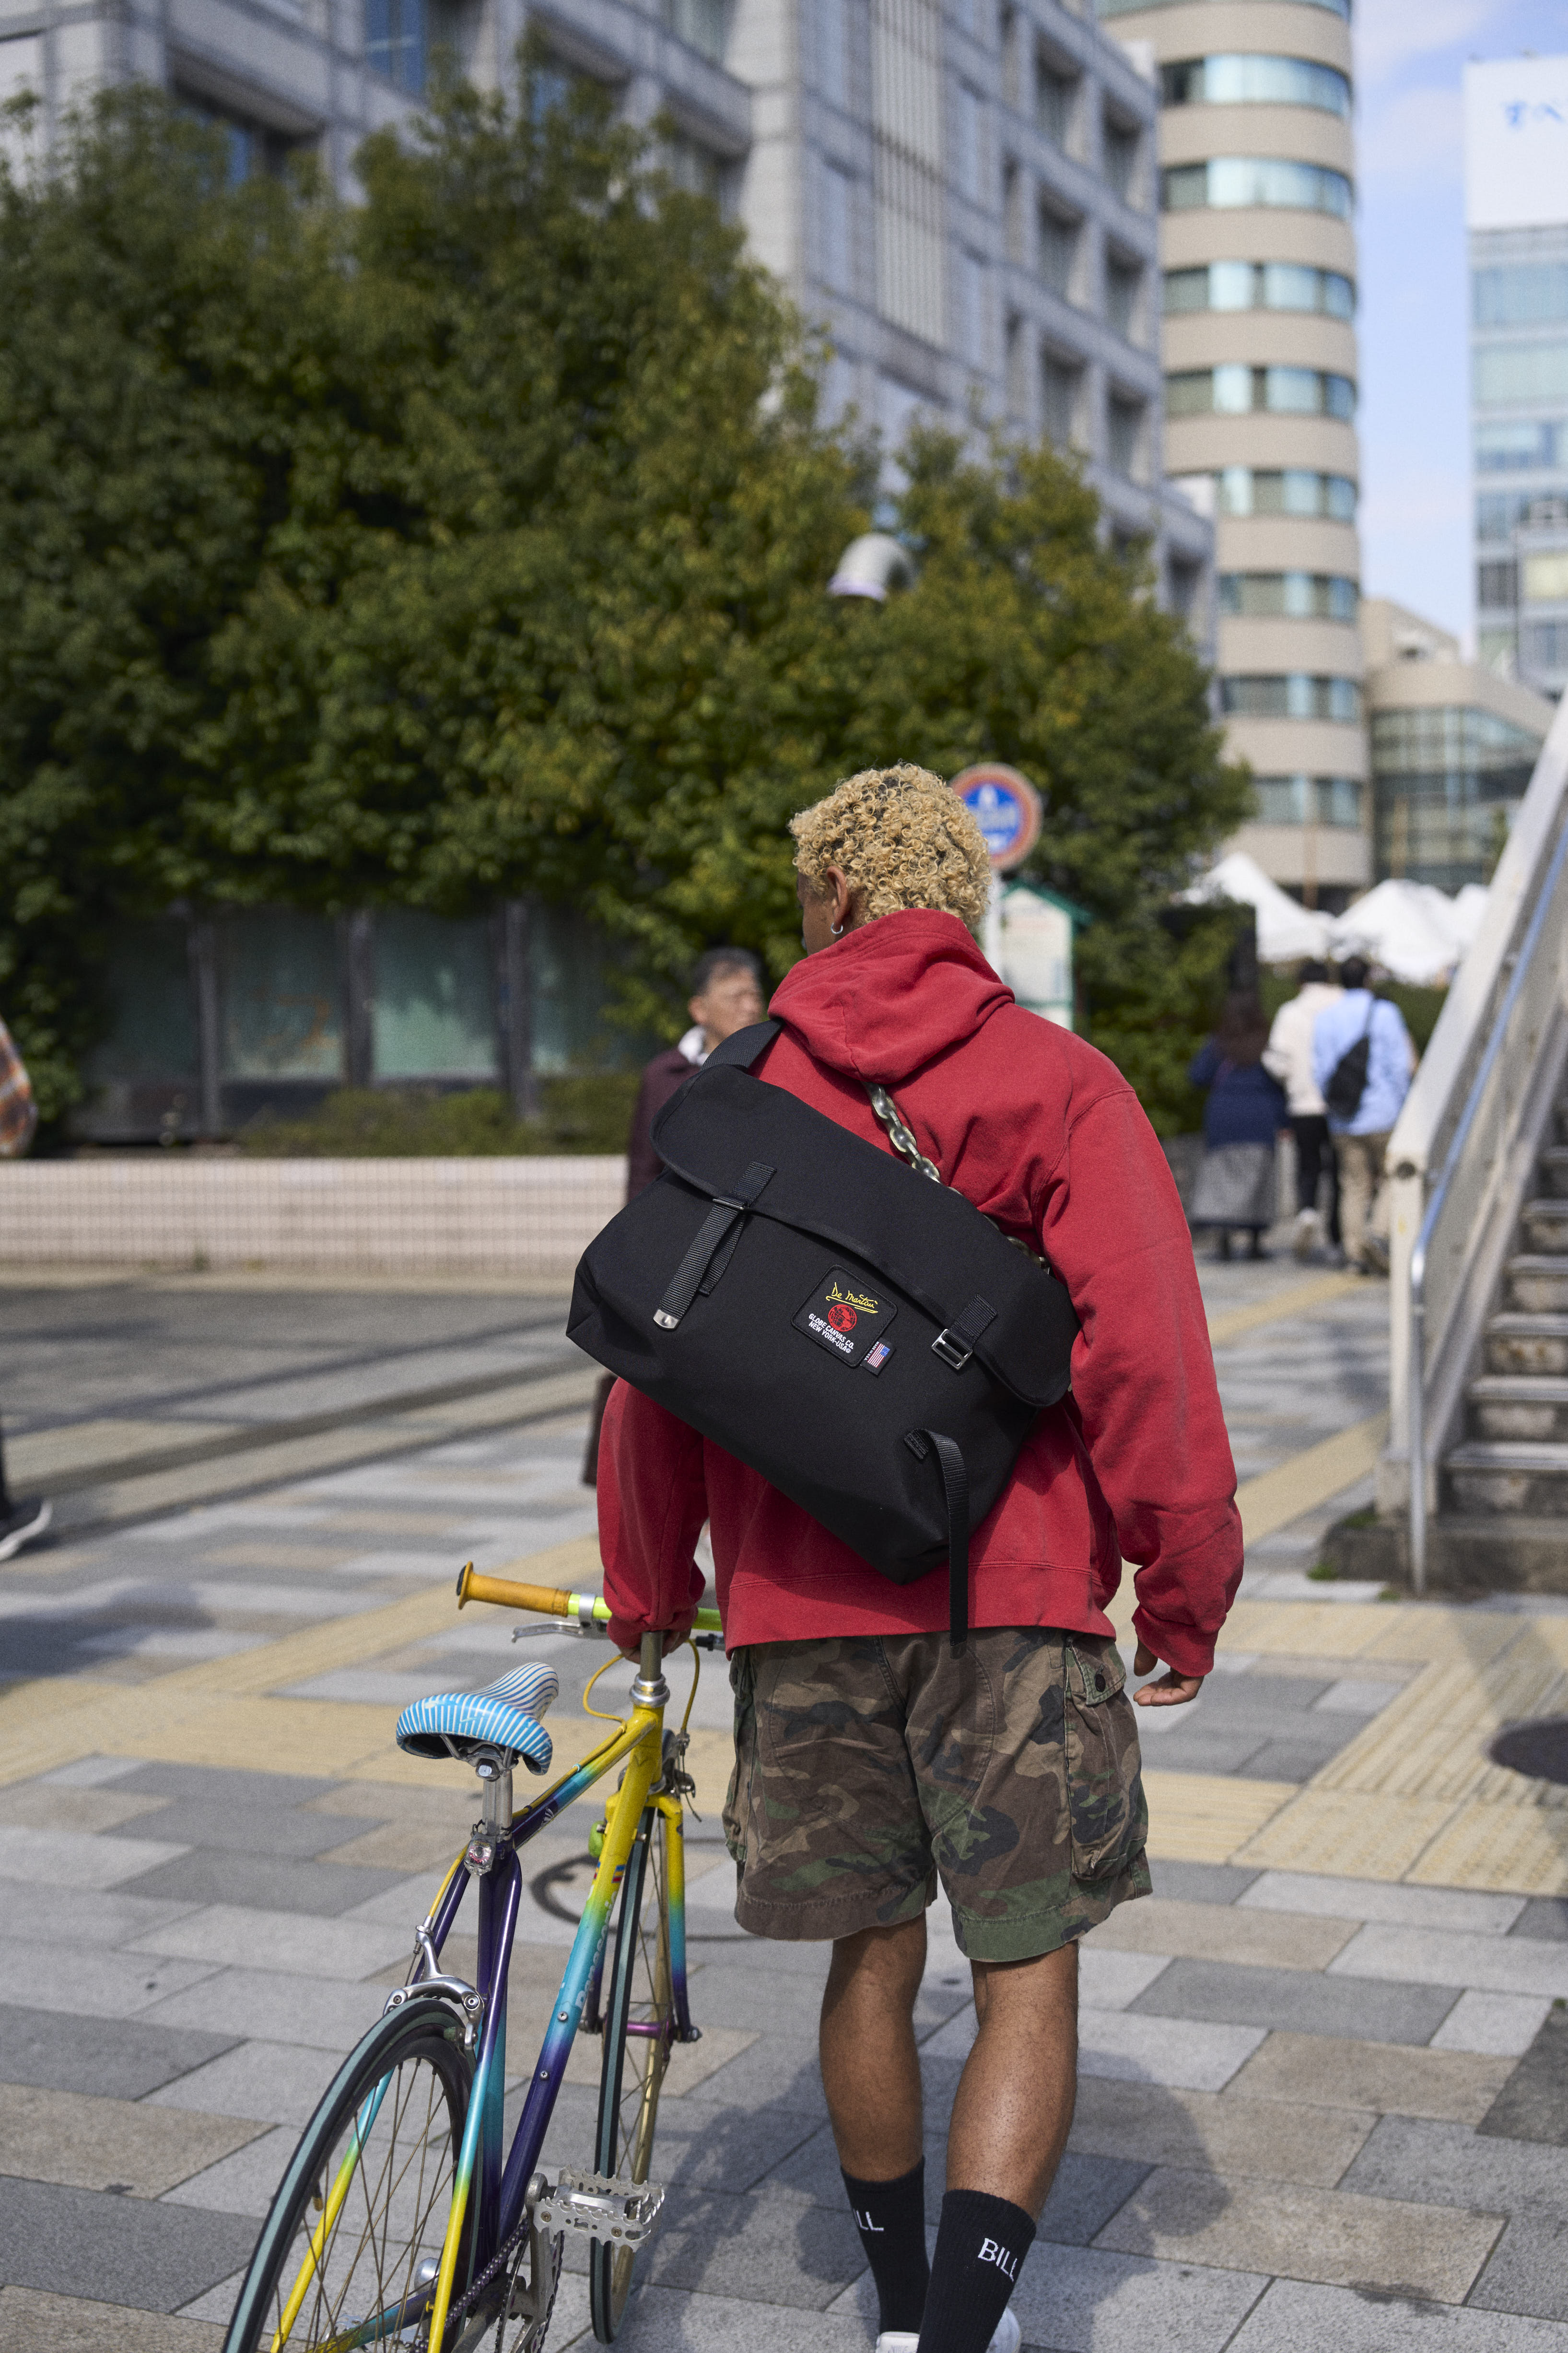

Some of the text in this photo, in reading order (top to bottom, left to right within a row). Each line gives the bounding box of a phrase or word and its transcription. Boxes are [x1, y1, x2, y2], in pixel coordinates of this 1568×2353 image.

[831, 1282, 842, 1299] De
[808, 1321, 822, 1332] NEW
[808, 1313, 854, 1349] GLOBE CANVAS CO.
